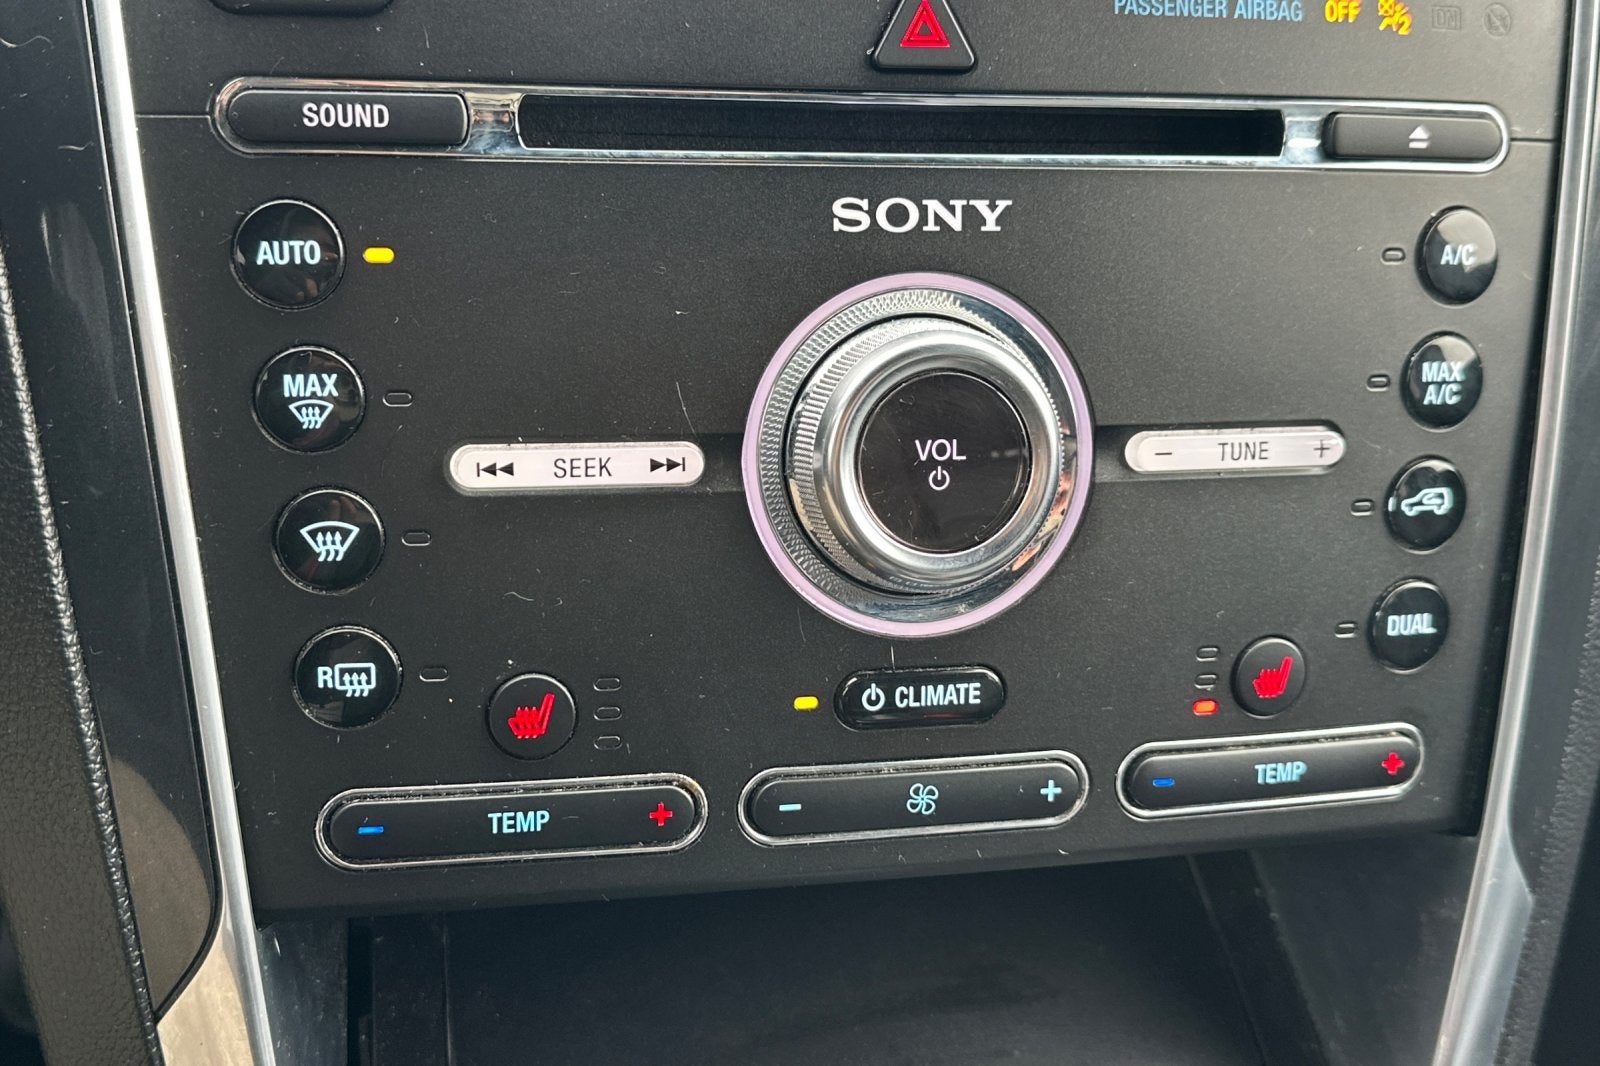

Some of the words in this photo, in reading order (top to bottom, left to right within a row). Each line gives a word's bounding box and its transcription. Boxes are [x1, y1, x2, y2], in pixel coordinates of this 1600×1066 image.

[1113, 0, 1227, 18] PASSENGER
[1233, 0, 1303, 22] AIRBAG
[1324, 0, 1361, 23] OFF
[302, 102, 390, 129] SOUND
[832, 198, 1012, 233] SONY
[256, 239, 321, 266] AUTO
[1440, 243, 1477, 268] A/C
[1421, 361, 1464, 383] MAX
[282, 373, 339, 398] MAX
[1423, 383, 1462, 407] A/C
[914, 439, 967, 461] VOL
[1217, 441, 1270, 462] TUNE
[553, 457, 613, 480] SEEK
[1386, 612, 1437, 637] DUAL
[317, 666, 335, 689] R
[894, 682, 982, 708] CLIMATE
[1254, 760, 1309, 786] TEMP
[487, 810, 550, 834] TEMP
